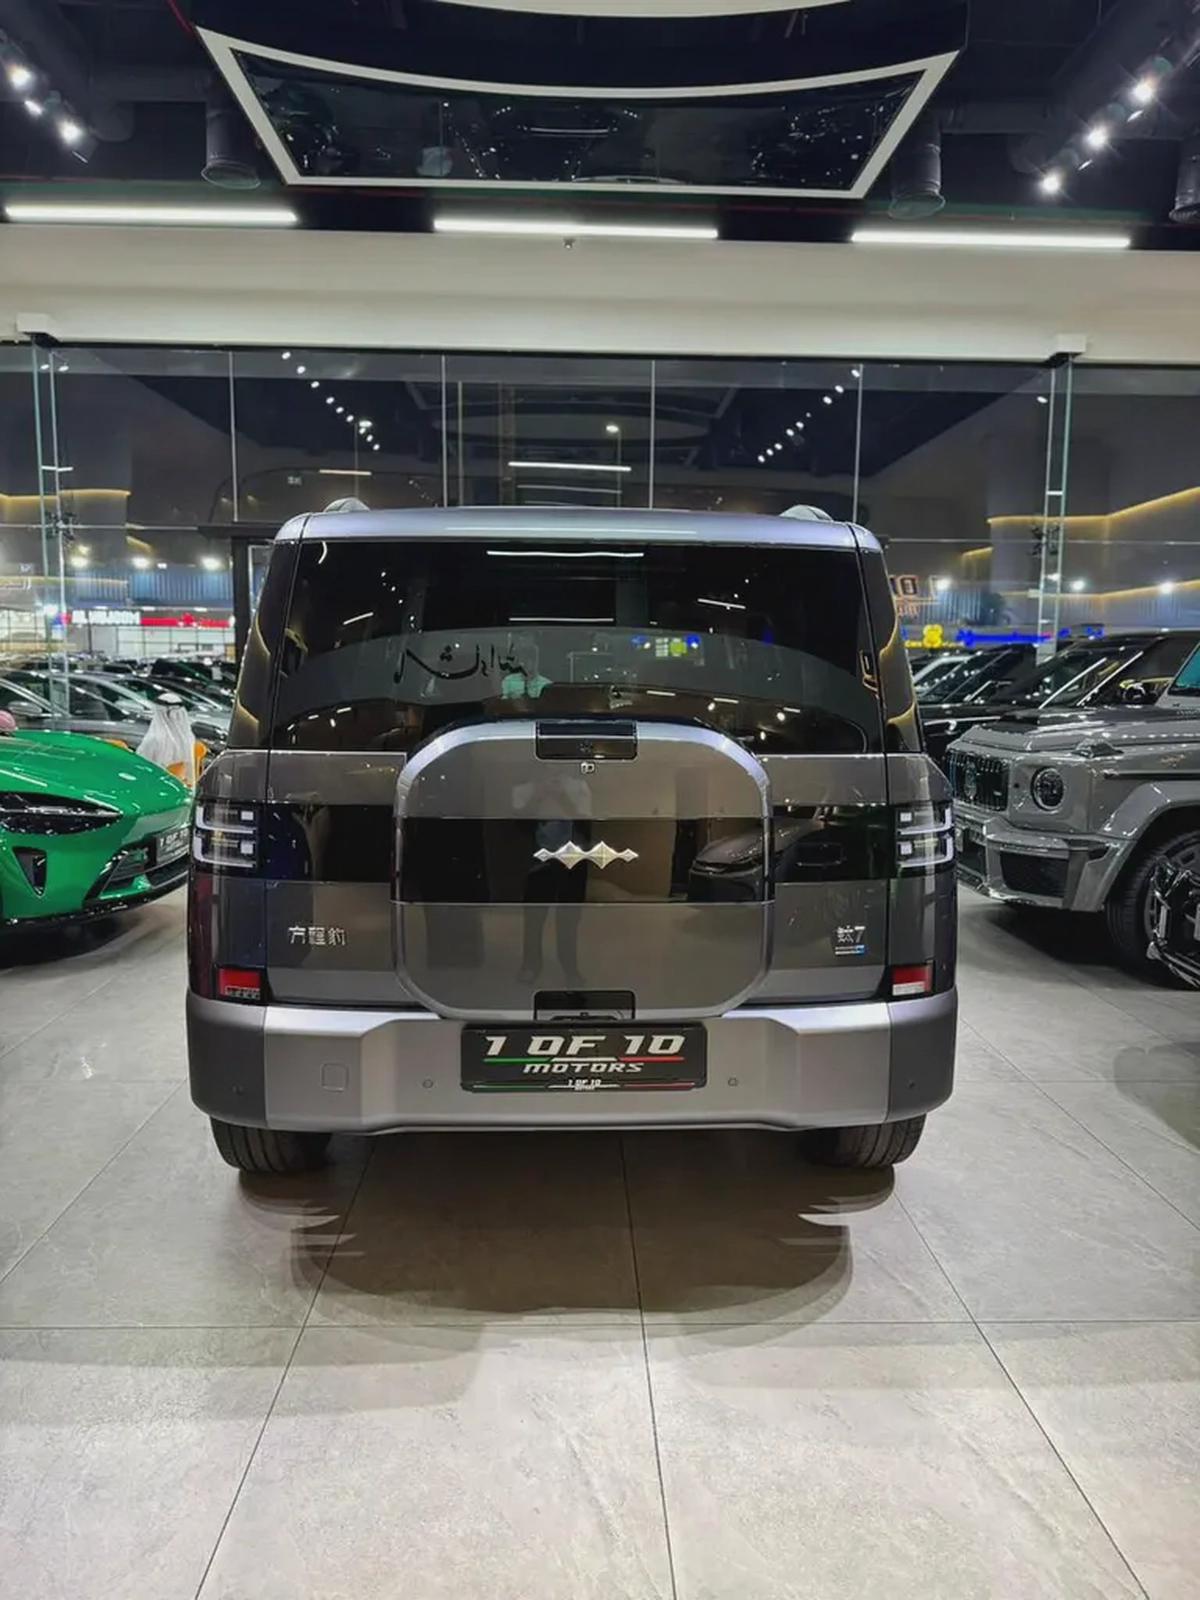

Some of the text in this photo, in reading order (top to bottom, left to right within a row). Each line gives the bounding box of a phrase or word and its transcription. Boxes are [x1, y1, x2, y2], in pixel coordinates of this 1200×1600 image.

[485, 1034, 686, 1056] 1 OF 10
[523, 1062, 645, 1074] MOTORS
